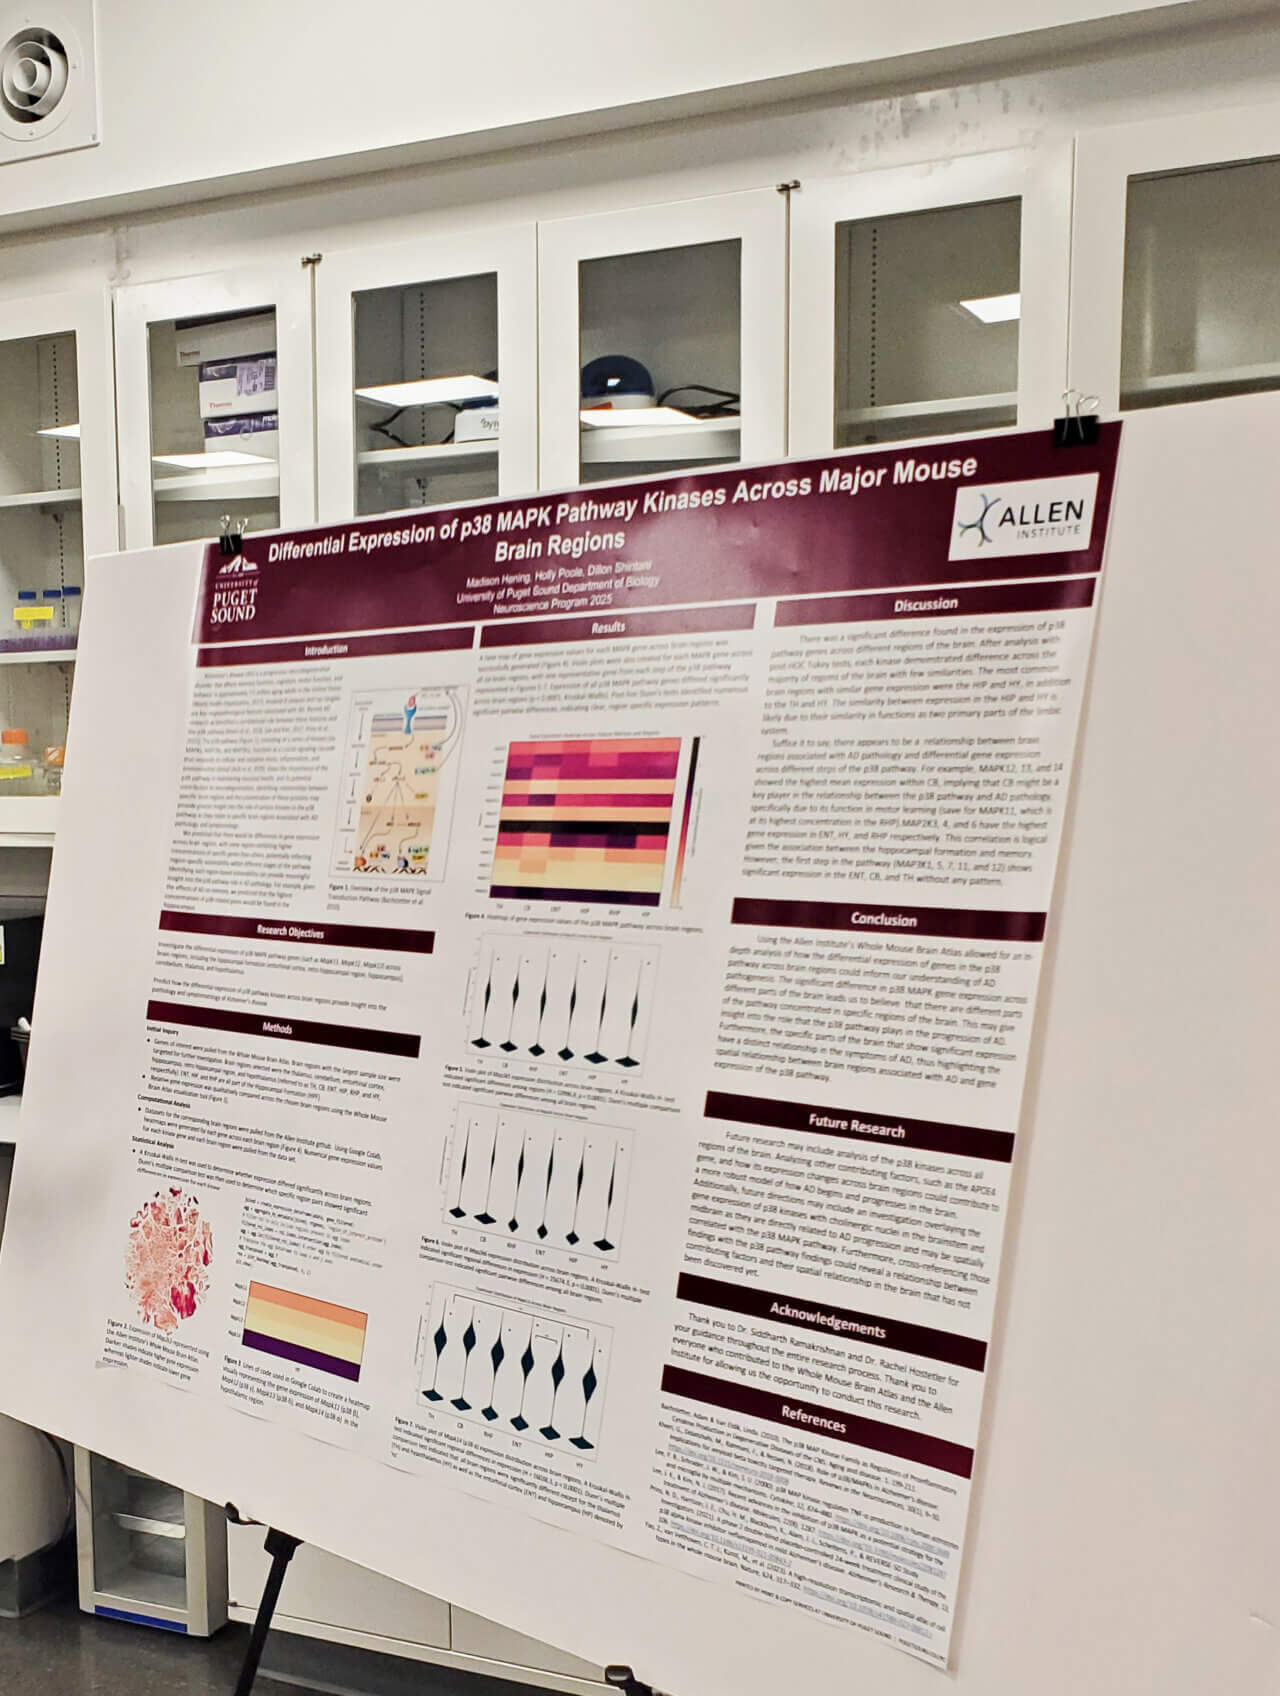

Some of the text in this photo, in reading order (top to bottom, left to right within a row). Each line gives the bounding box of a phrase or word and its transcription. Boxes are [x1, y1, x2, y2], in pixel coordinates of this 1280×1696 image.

[269, 457, 978, 562] Differential Expression of p38 MAPK Pathway Kinases Across Major Mouse
[998, 499, 1084, 528] ALLEN
[1017, 525, 1080, 539] INSTITUTE
[495, 531, 626, 562] Brain Regions
[466, 577, 500, 588] Madison
[535, 569, 557, 582] Holly
[588, 564, 612, 576] Dillon
[213, 588, 258, 608] PUGET
[457, 576, 660, 604] University of Puget Sound Department of Biology
[210, 604, 256, 624] SOUND
[494, 594, 612, 615] Neuroscience Program 2025
[894, 597, 958, 612] Discussion
[592, 620, 625, 634] Results
[304, 644, 348, 657] Introduction
[257, 924, 324, 940] Research Objectives
[850, 911, 918, 928] Conclusion
[263, 1021, 293, 1035] Methods
[809, 1112, 906, 1139] Future Research
[770, 1302, 887, 1339] Acknowledgements
[674, 1324, 690, 1332] your
[691, 1328, 725, 1341] guidance
[727, 1336, 770, 1353] throughout
[771, 1347, 785, 1357] the
[786, 1351, 810, 1363] entire
[811, 1358, 846, 1371] research
[885, 1374, 909, 1388] Thank
[911, 1383, 926, 1392] you
[928, 1386, 937, 1395] to
[689, 1312, 710, 1324] Thank
[712, 1320, 726, 1328] you
[727, 1322, 736, 1331] to
[847, 1352, 863, 1362] and
[879, 1359, 907, 1372] Rachel
[947, 1375, 959, 1386] for
[670, 1347, 701, 1362] Institute
[702, 1355, 713, 1365] for
[714, 1359, 746, 1376] allowing
[747, 1369, 757, 1377] us
[758, 1370, 772, 1381] the
[773, 1375, 819, 1394] opportunity
[821, 1387, 831, 1396] to
[831, 1391, 864, 1405] conduct
[866, 1399, 882, 1410] this
[672, 1336, 952, 1413] everyone who contributed to the Whole Mouse Brain Atlas and the Allen
[782, 1404, 846, 1434] References
